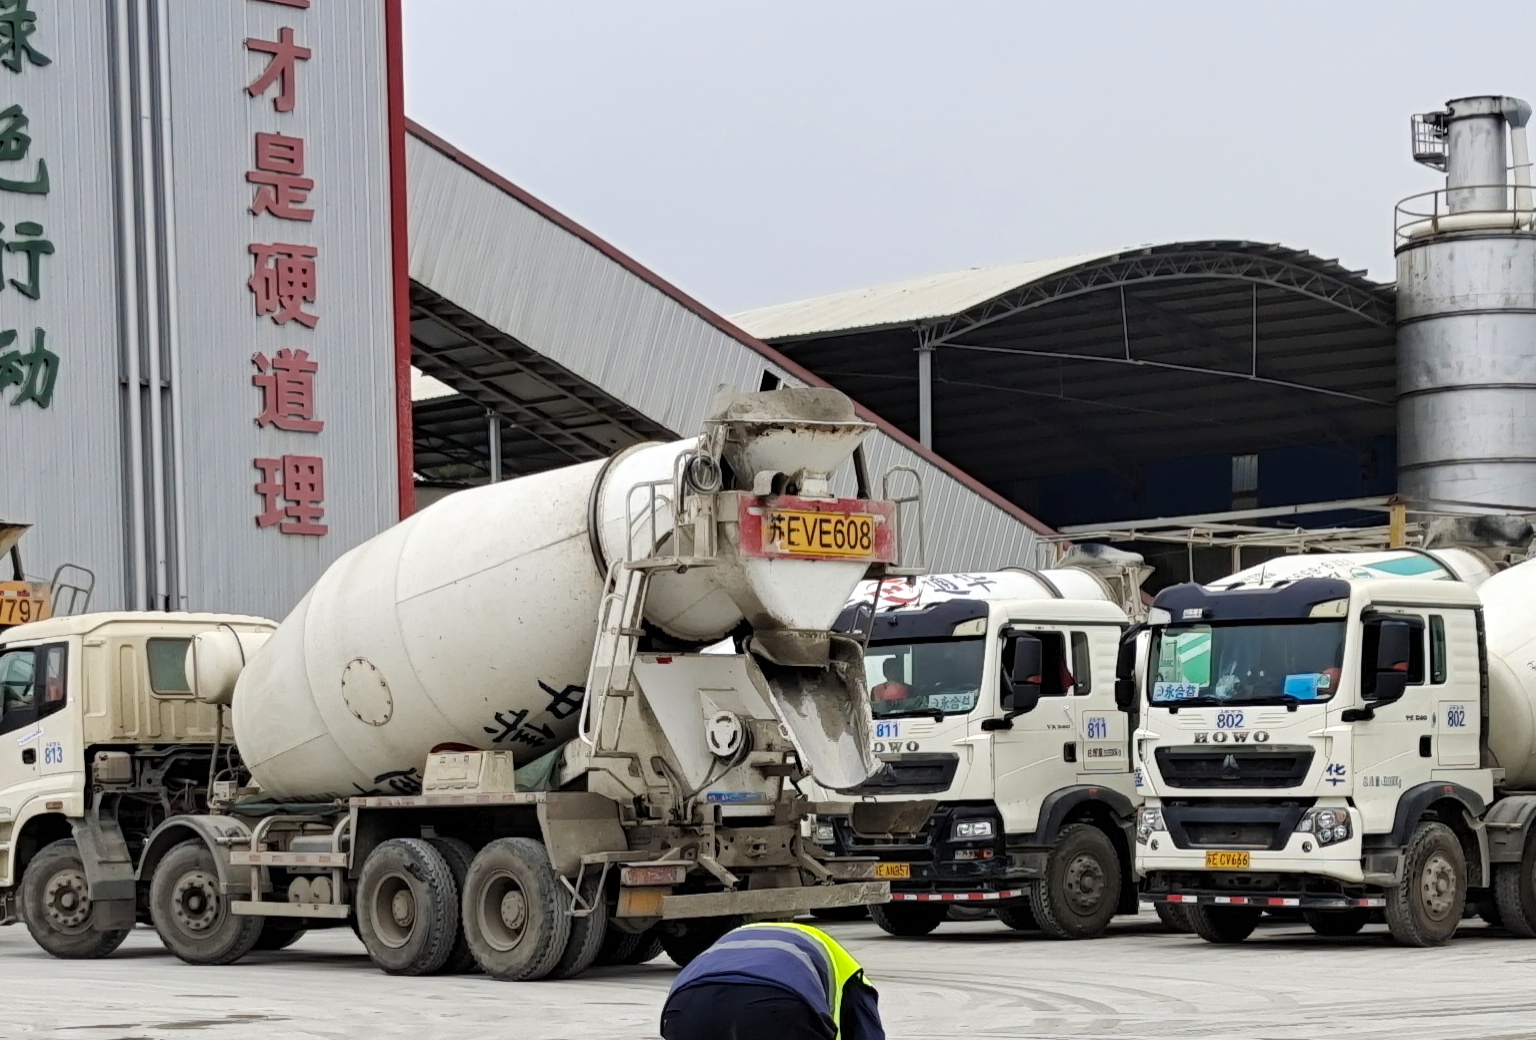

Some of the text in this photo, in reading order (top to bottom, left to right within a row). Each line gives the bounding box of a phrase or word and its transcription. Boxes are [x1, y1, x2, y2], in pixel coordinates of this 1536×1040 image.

[243, 0, 329, 536] 才是硬道理
[770, 513, 872, 550] 苏EVE608
[1217, 713, 1245, 728] 802
[1447, 710, 1466, 727] 802
[877, 723, 899, 737] 811
[1087, 722, 1107, 739] 811
[1193, 731, 1270, 744] HOWO
[45, 746, 63, 764] 813
[872, 740, 920, 753] OWO
[1325, 763, 1346, 787] 华
